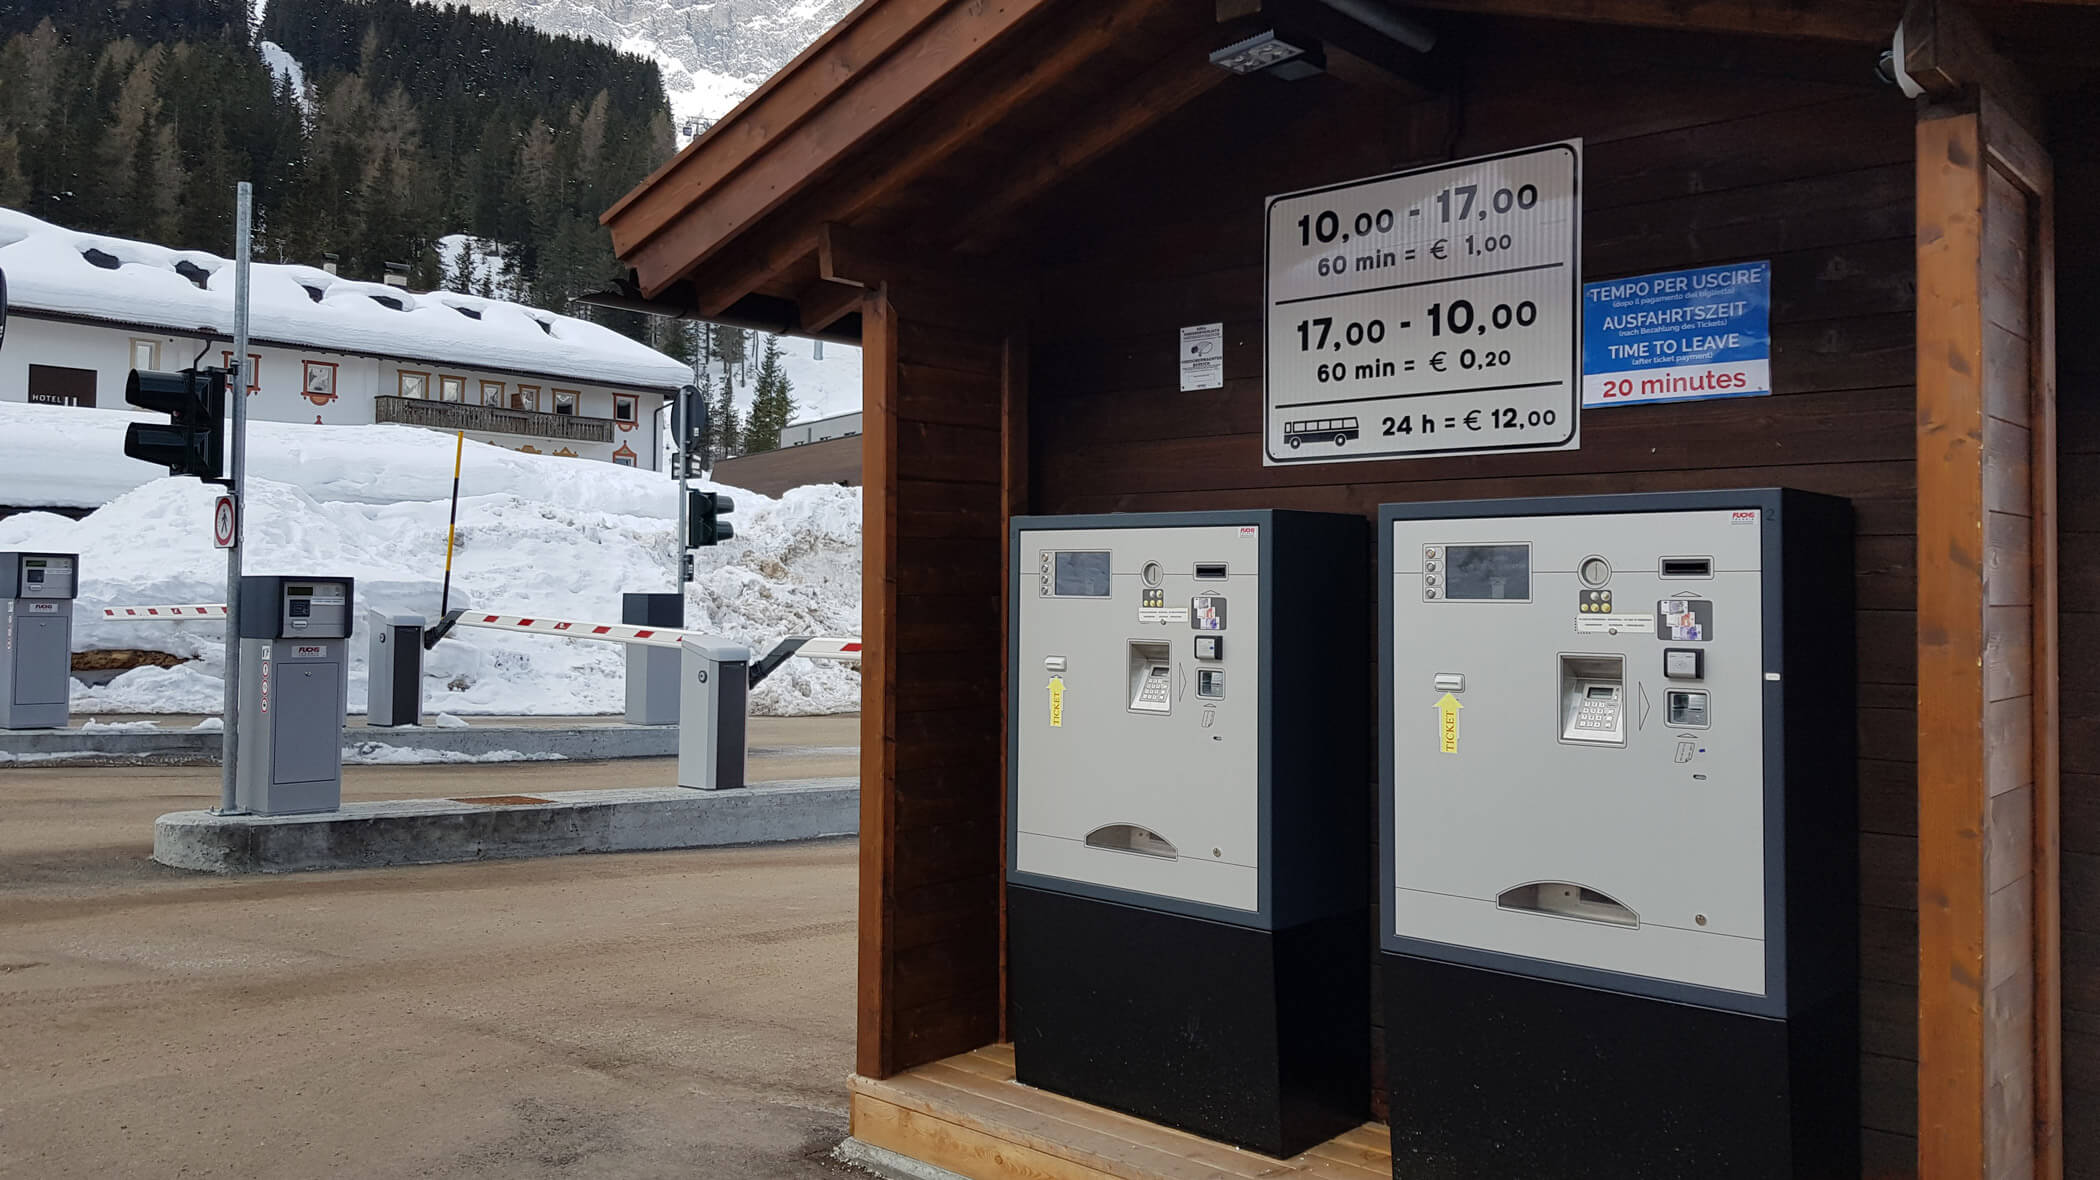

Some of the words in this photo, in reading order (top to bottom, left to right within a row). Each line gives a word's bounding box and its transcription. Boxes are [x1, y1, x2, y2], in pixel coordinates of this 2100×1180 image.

[1298, 209, 1394, 246] 10,00
[1409, 209, 1420, 217] -
[1437, 184, 1538, 223] 17,00
[1318, 255, 1347, 277] 60
[1356, 249, 1396, 272] min
[1405, 250, 1416, 261] =
[1430, 238, 1448, 260] €
[1465, 234, 1512, 256] 1,00
[1591, 282, 1649, 302] TEMPO
[1654, 277, 1688, 294] PER
[1693, 268, 1761, 289] USCIRE
[1297, 317, 1385, 352] 17,00
[1427, 300, 1536, 336] 10,00
[1603, 301, 1747, 330] AUSFAHRTSZEIT
[1608, 342, 1649, 359] TIME
[1653, 340, 1677, 355] TO
[1682, 333, 1740, 352] LEAVE
[1653, 355, 1675, 363] ticket
[1317, 362, 1346, 383] 60
[1355, 358, 1395, 380] min
[1404, 360, 1415, 371] =
[1429, 351, 1447, 372] €
[1460, 349, 1511, 370] 0,20
[32, 394, 62, 403] HOTEL
[1603, 379, 1633, 398] 20
[1641, 370, 1747, 395] minutes
[1382, 416, 1412, 436] 24
[1422, 415, 1435, 434] h
[1444, 417, 1455, 429] =
[1463, 409, 1482, 431] €
[1491, 408, 1556, 430] 12,00
[1445, 710, 1455, 751] TICKET
